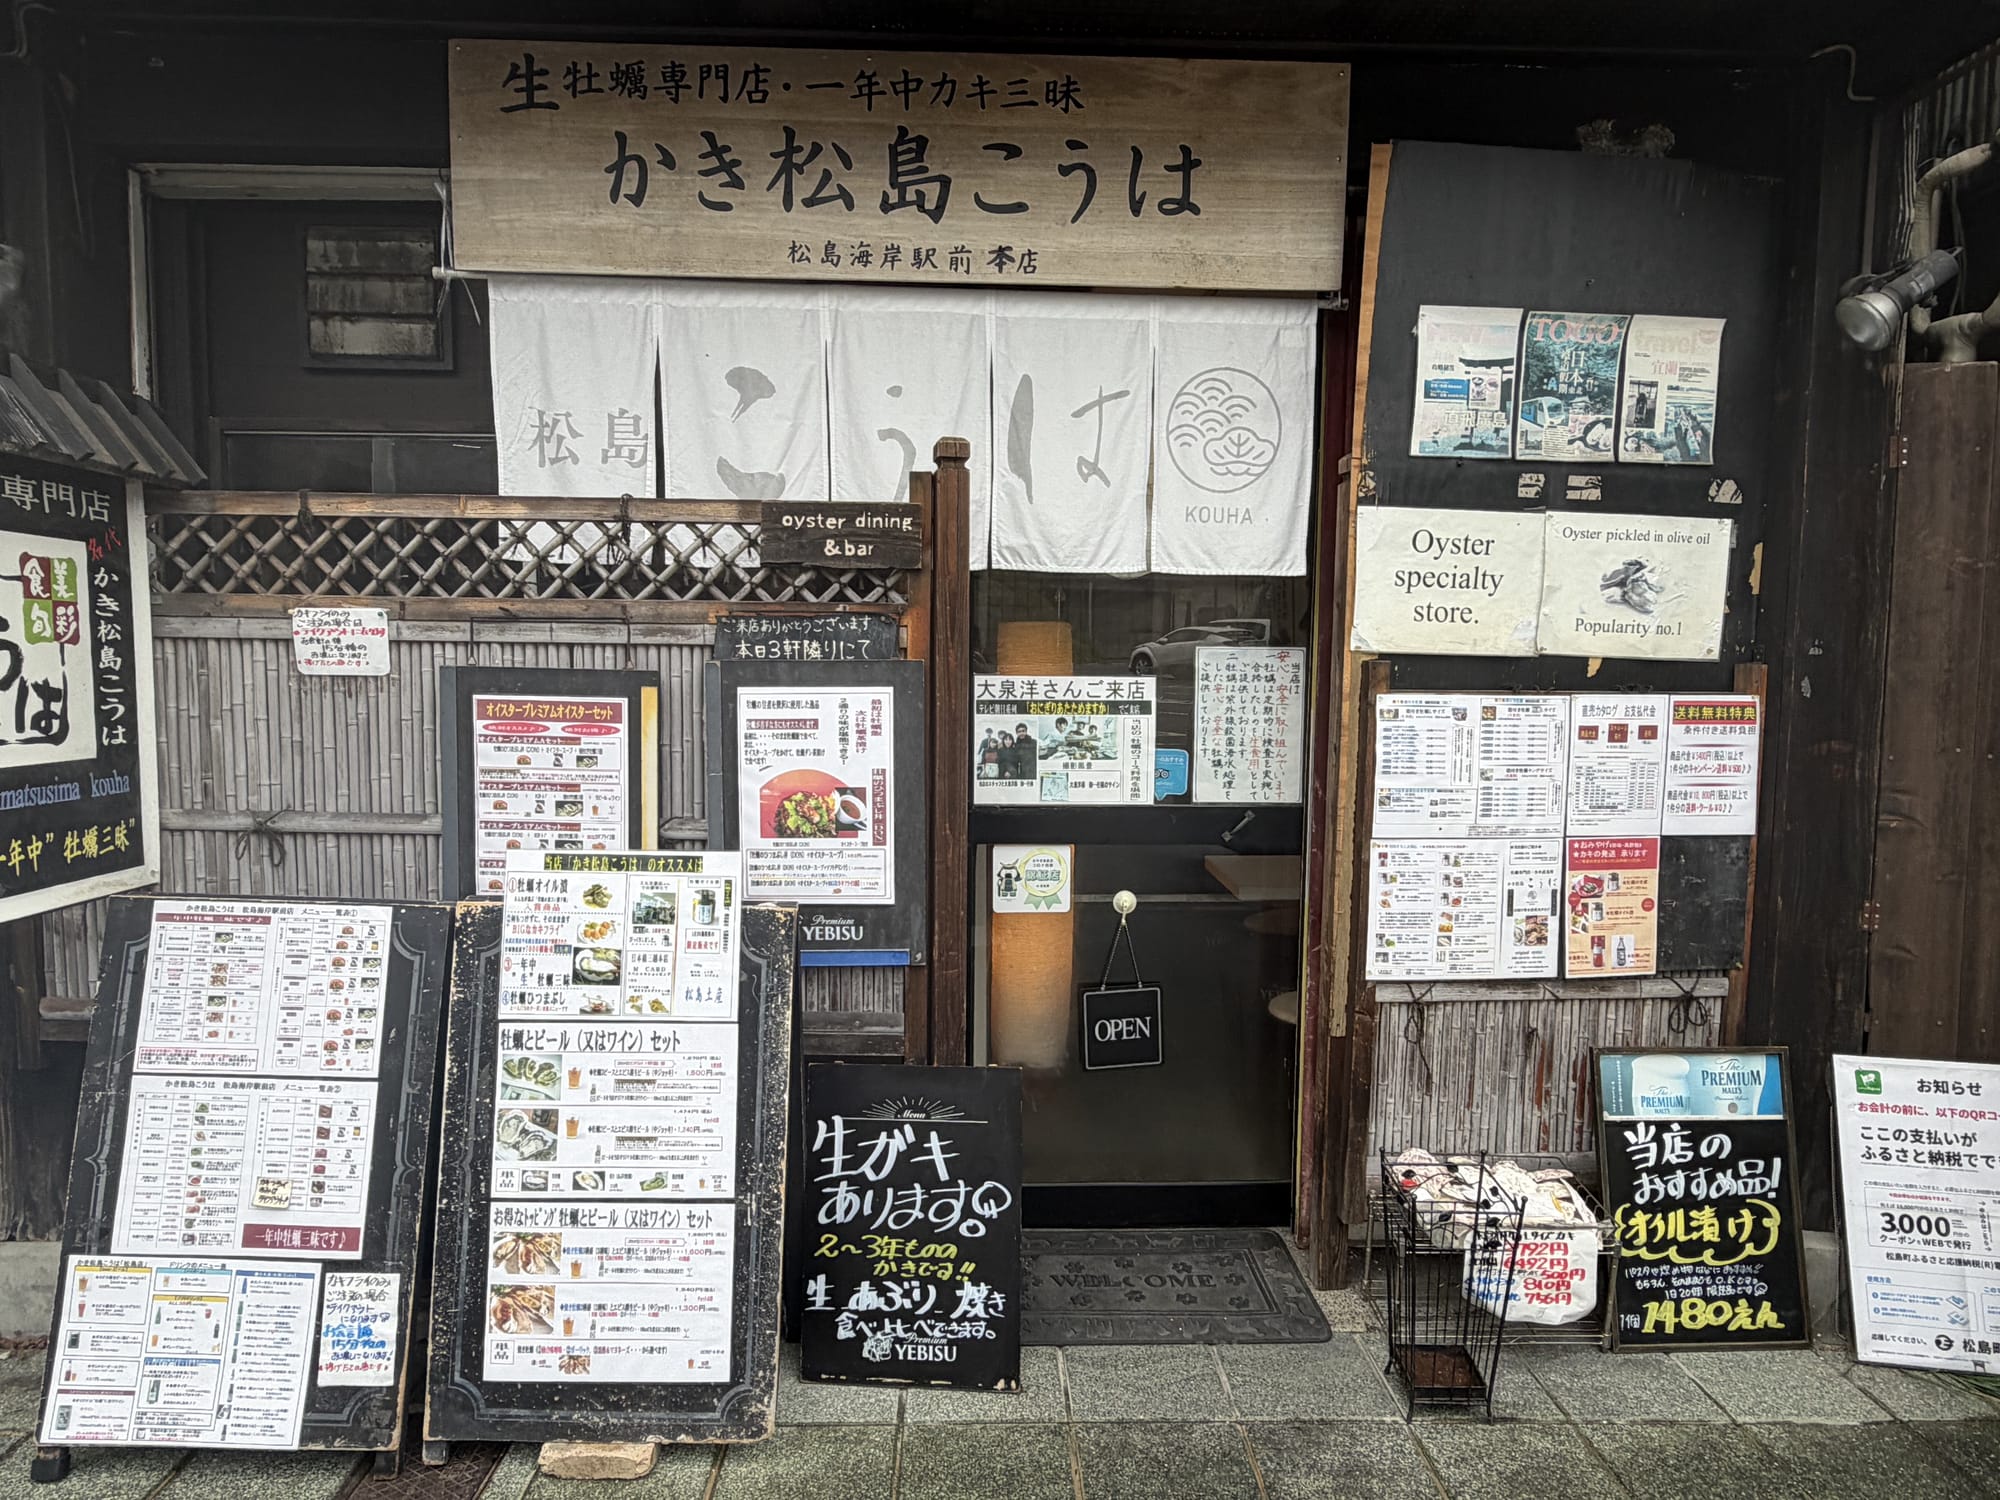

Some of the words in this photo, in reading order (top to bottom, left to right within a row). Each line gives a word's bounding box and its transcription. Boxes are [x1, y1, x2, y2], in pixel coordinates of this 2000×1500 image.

[604, 124, 1203, 225] かき松島こうは
[528, 407, 649, 468] 松島
[782, 512, 847, 535] oyster
[855, 511, 913, 531] dining
[1185, 505, 1254, 525] KOUHA
[1411, 528, 1495, 560] Oyster
[1562, 526, 1602, 542] Oyster
[1605, 528, 1650, 543] pickled
[1654, 530, 1663, 542] in
[1667, 531, 1693, 543] olive
[1696, 531, 1710, 545] oil
[1394, 565, 1504, 596] specialty
[721, 615, 871, 634] ご来店ありがとうございます
[1413, 602, 1479, 625] store.
[1574, 617, 1650, 638] Popularity
[93, 566, 128, 746] かき松島こうは
[735, 639, 871, 660] 本日3軒隣りにて
[977, 680, 1146, 699] 大泉洋さんご来店
[1289, 664, 1300, 695] 当店は
[1674, 707, 1756, 720] 送料無料特典
[89, 769, 130, 797] kouha
[802, 926, 863, 941] YEBISU
[1095, 1017, 1151, 1042] OPEN
[1702, 1070, 1761, 1086] PREMIUM
[1917, 1079, 1982, 1096] お知らせ
[1641, 1095, 1684, 1108] PREMIUM
[1859, 1102, 2000, 1121] お会計の前に、以下のQRコ
[1624, 1121, 1731, 1170] 当店の
[1861, 1126, 1977, 1147] ここの支払いが
[1861, 1145, 2000, 1169] ふるさと納税でで
[1633, 1157, 1781, 1205] おすすめ品!
[1880, 1212, 1950, 1237] 3,000
[895, 1344, 957, 1362] YEBISU
